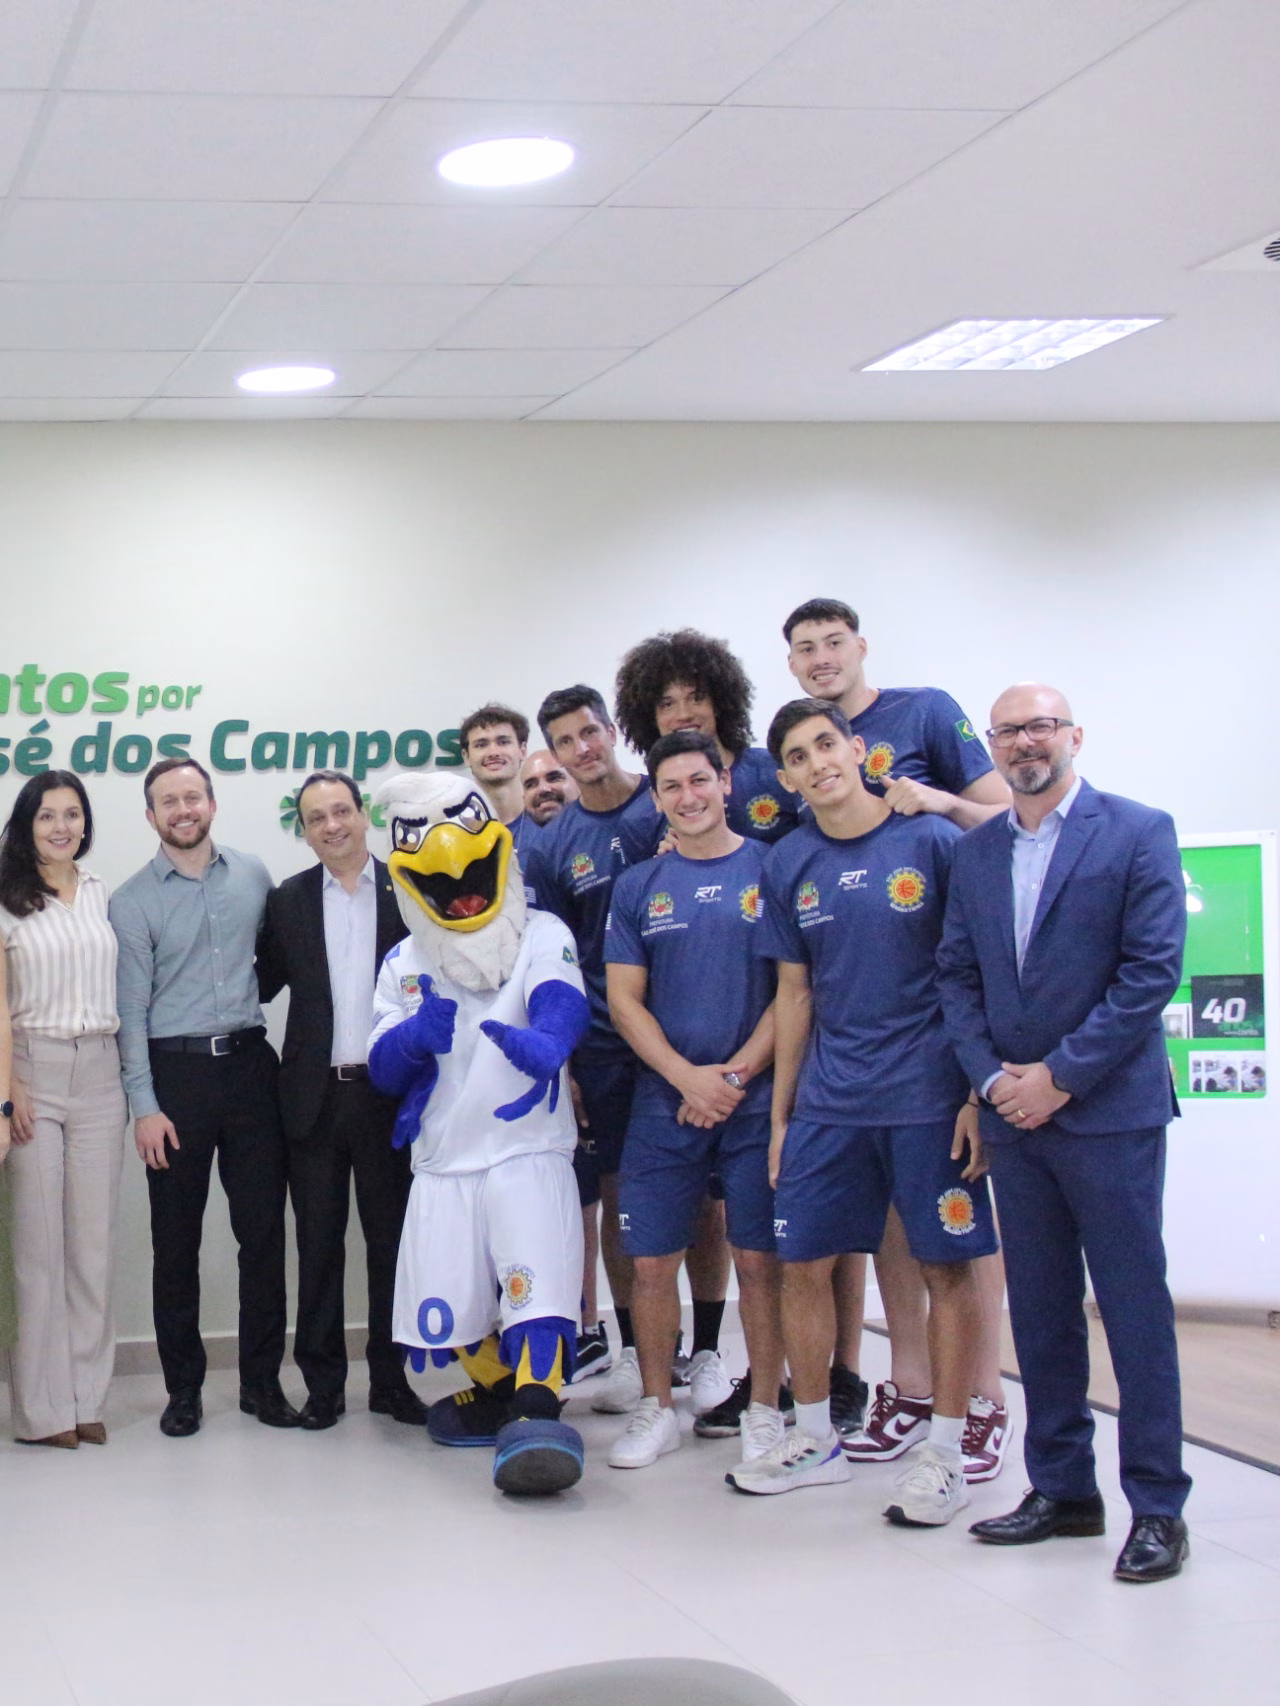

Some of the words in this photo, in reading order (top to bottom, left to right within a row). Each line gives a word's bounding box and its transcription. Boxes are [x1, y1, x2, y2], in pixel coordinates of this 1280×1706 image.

[136, 684, 203, 717] por
[209, 719, 465, 781] Campos
[694, 885, 722, 899] RT
[838, 869, 868, 887] RT
[1201, 997, 1247, 1024] 40
[417, 1296, 455, 1346] 0
